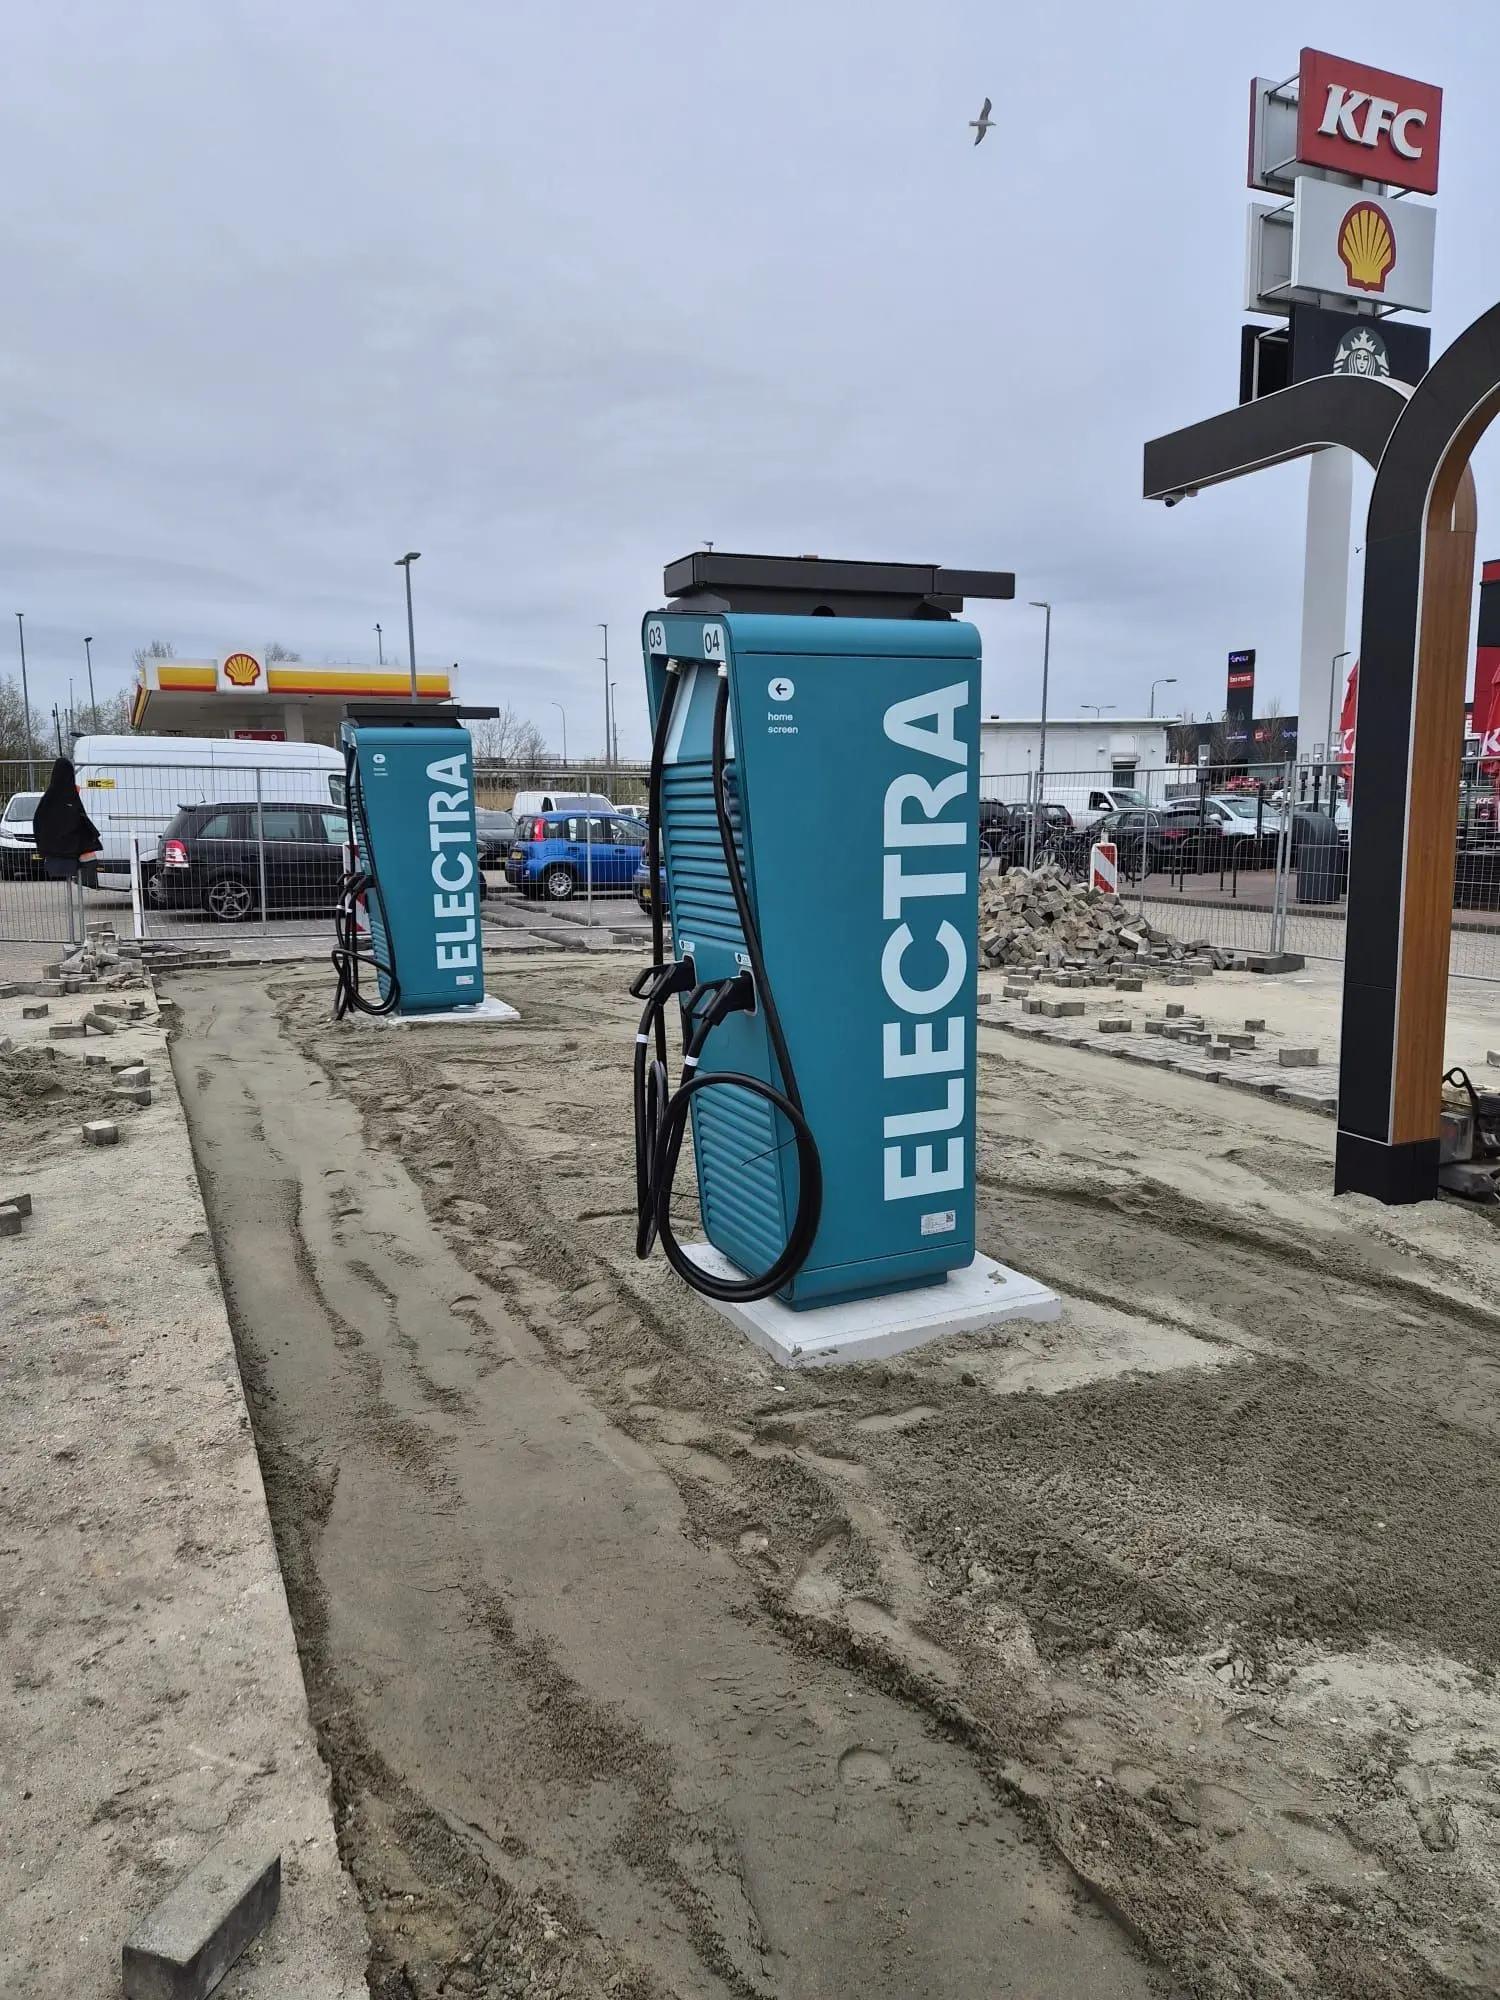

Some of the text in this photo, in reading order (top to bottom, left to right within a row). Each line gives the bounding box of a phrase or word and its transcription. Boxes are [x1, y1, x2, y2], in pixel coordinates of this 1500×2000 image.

[1317, 84, 1428, 160] KFC
[649, 626, 662, 648] 03
[704, 630, 721, 653] 04
[768, 711, 793, 721] home
[767, 726, 799, 734] screen
[426, 753, 478, 969] ELECTRA
[881, 680, 969, 1201] ELECTRA
